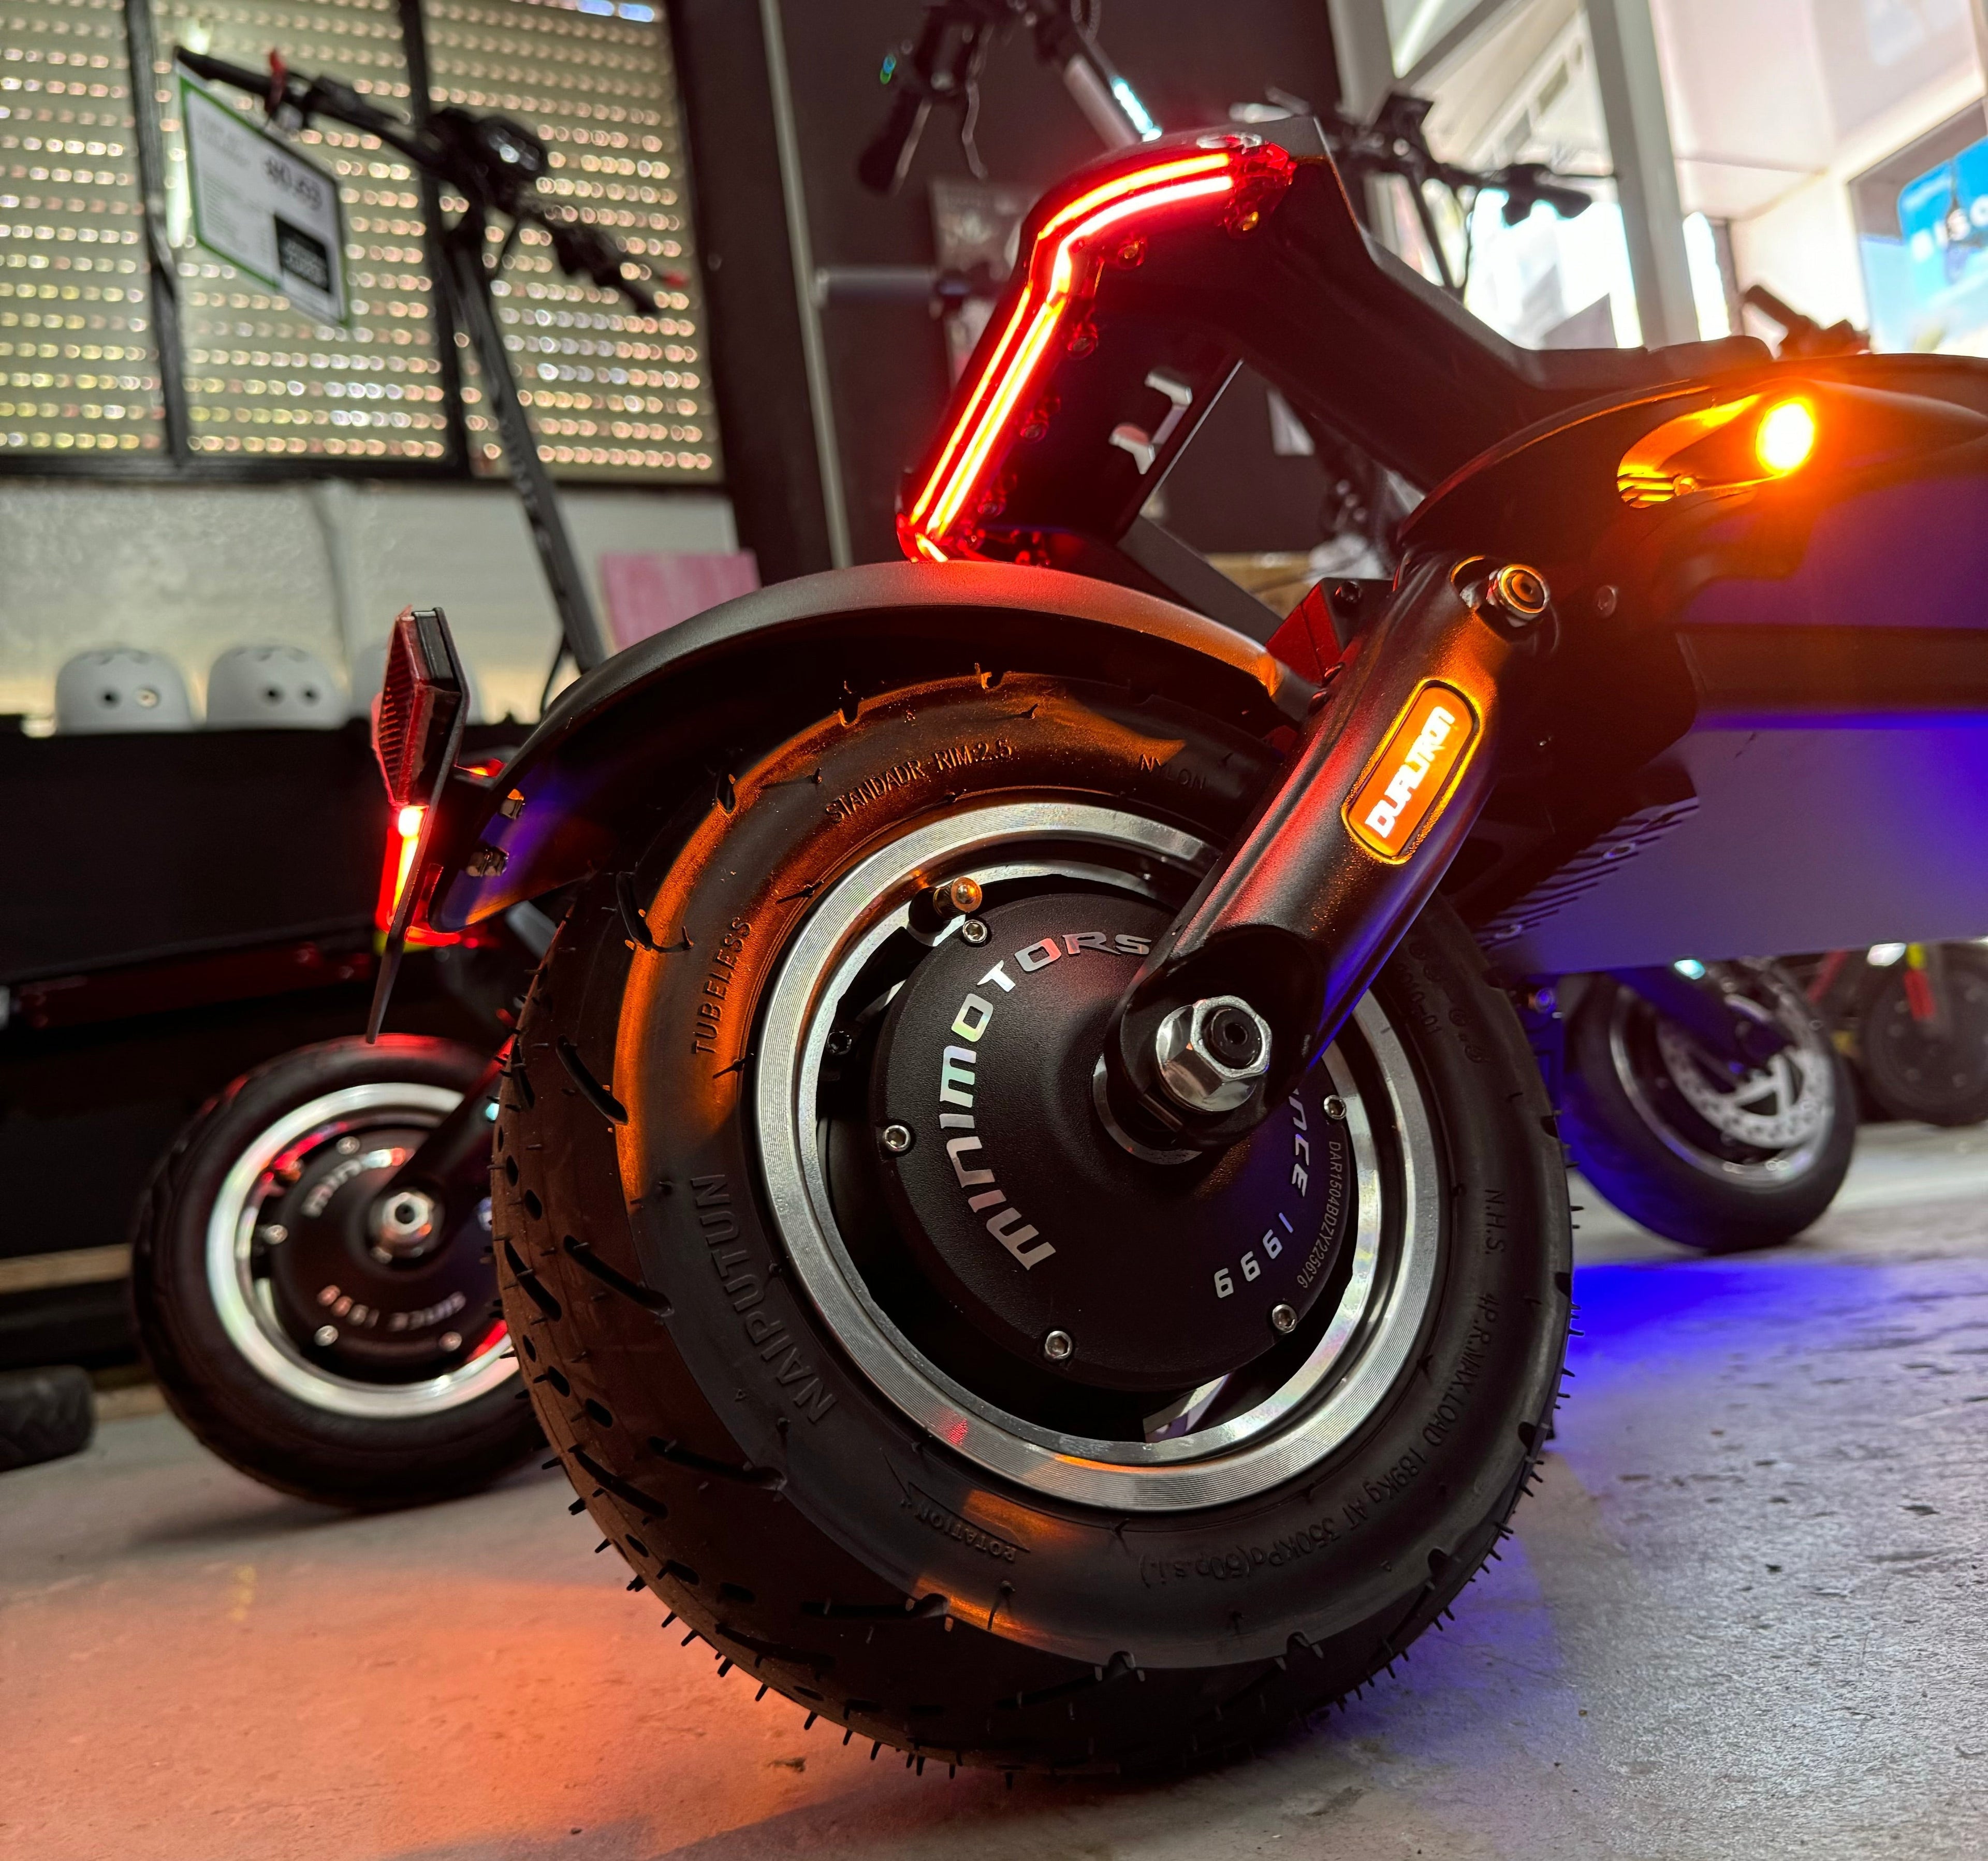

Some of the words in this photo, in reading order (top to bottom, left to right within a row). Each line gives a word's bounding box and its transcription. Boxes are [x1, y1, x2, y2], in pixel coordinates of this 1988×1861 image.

[691, 917, 751, 1054] TUBELESS
[1288, 1088, 1309, 1198] NCE
[689, 1173, 839, 1425] NAIPUTUN
[1214, 1212, 1294, 1299] 1999
[914, 1501, 1016, 1563] ROTATION
